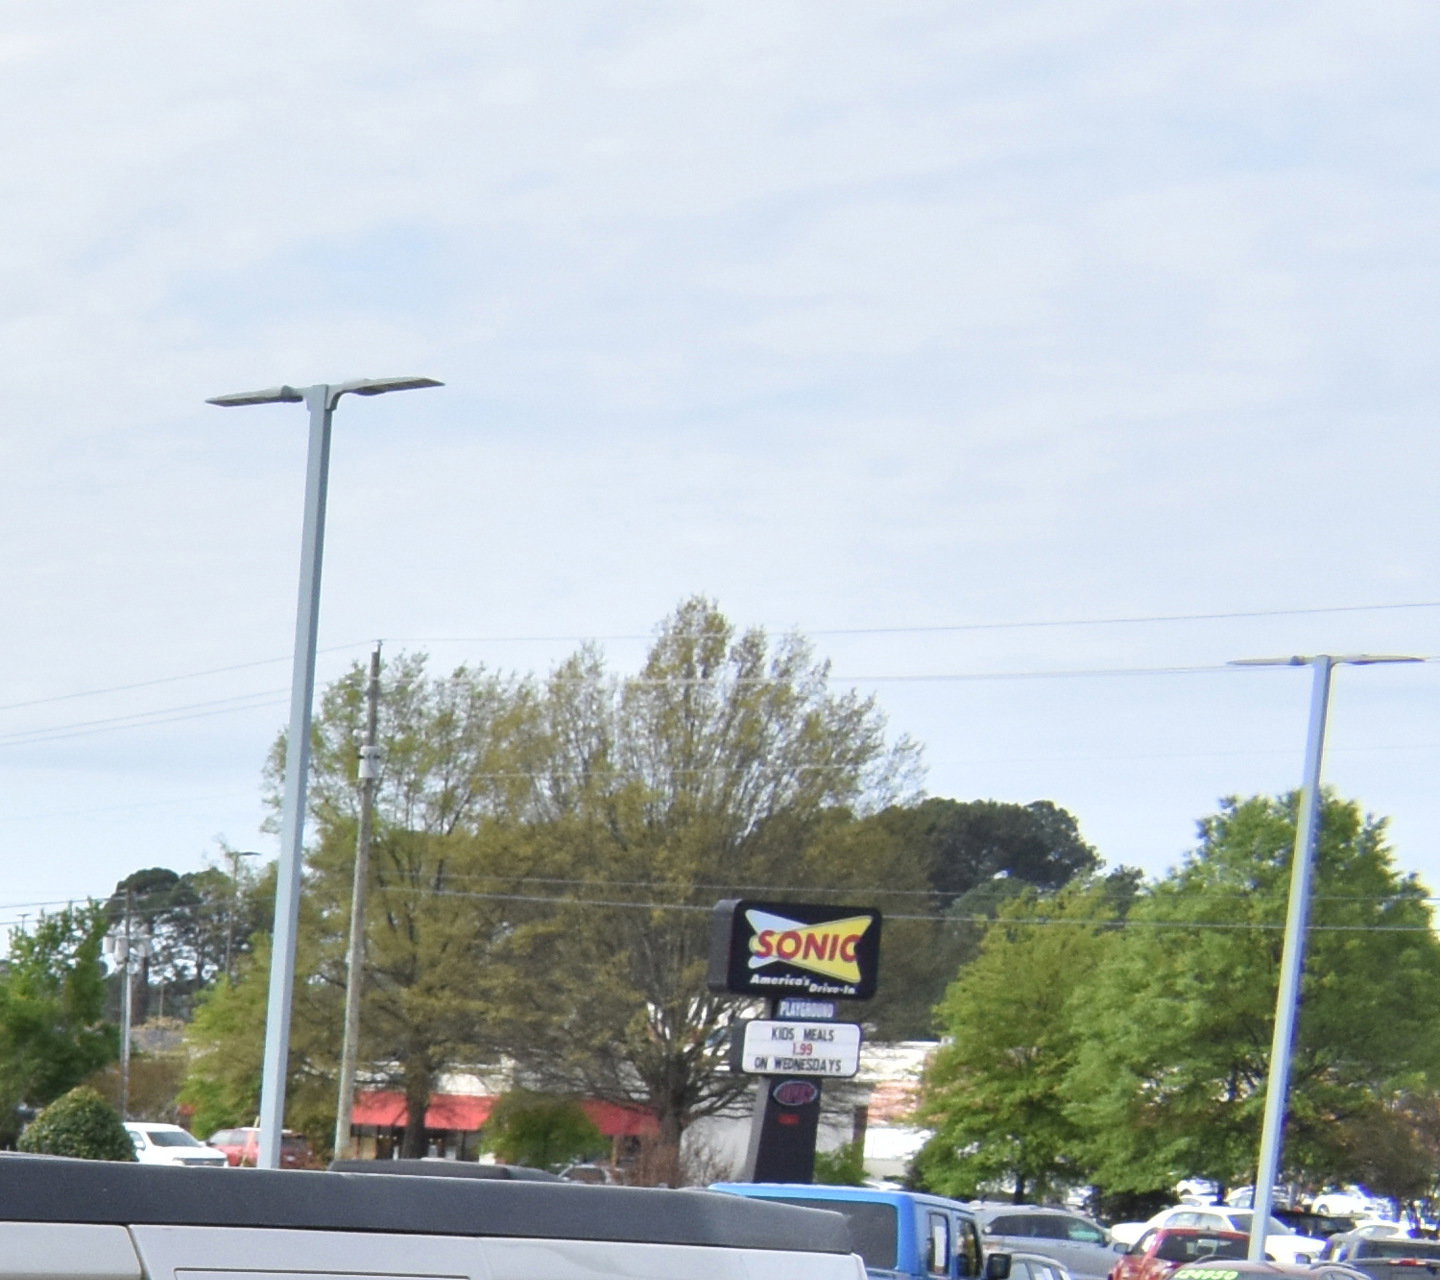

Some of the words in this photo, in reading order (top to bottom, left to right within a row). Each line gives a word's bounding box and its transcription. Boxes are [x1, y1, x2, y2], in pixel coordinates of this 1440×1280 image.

[753, 930, 862, 963] SONIC
[750, 974, 810, 987] America's
[780, 1001, 835, 1018] PLAYGROUND
[771, 1027, 795, 1040] KIDS
[803, 1028, 835, 1042] MEALS
[792, 1043, 813, 1056] 1.99
[754, 1057, 769, 1070] ON
[774, 1057, 842, 1072] WEDNESDAYS
